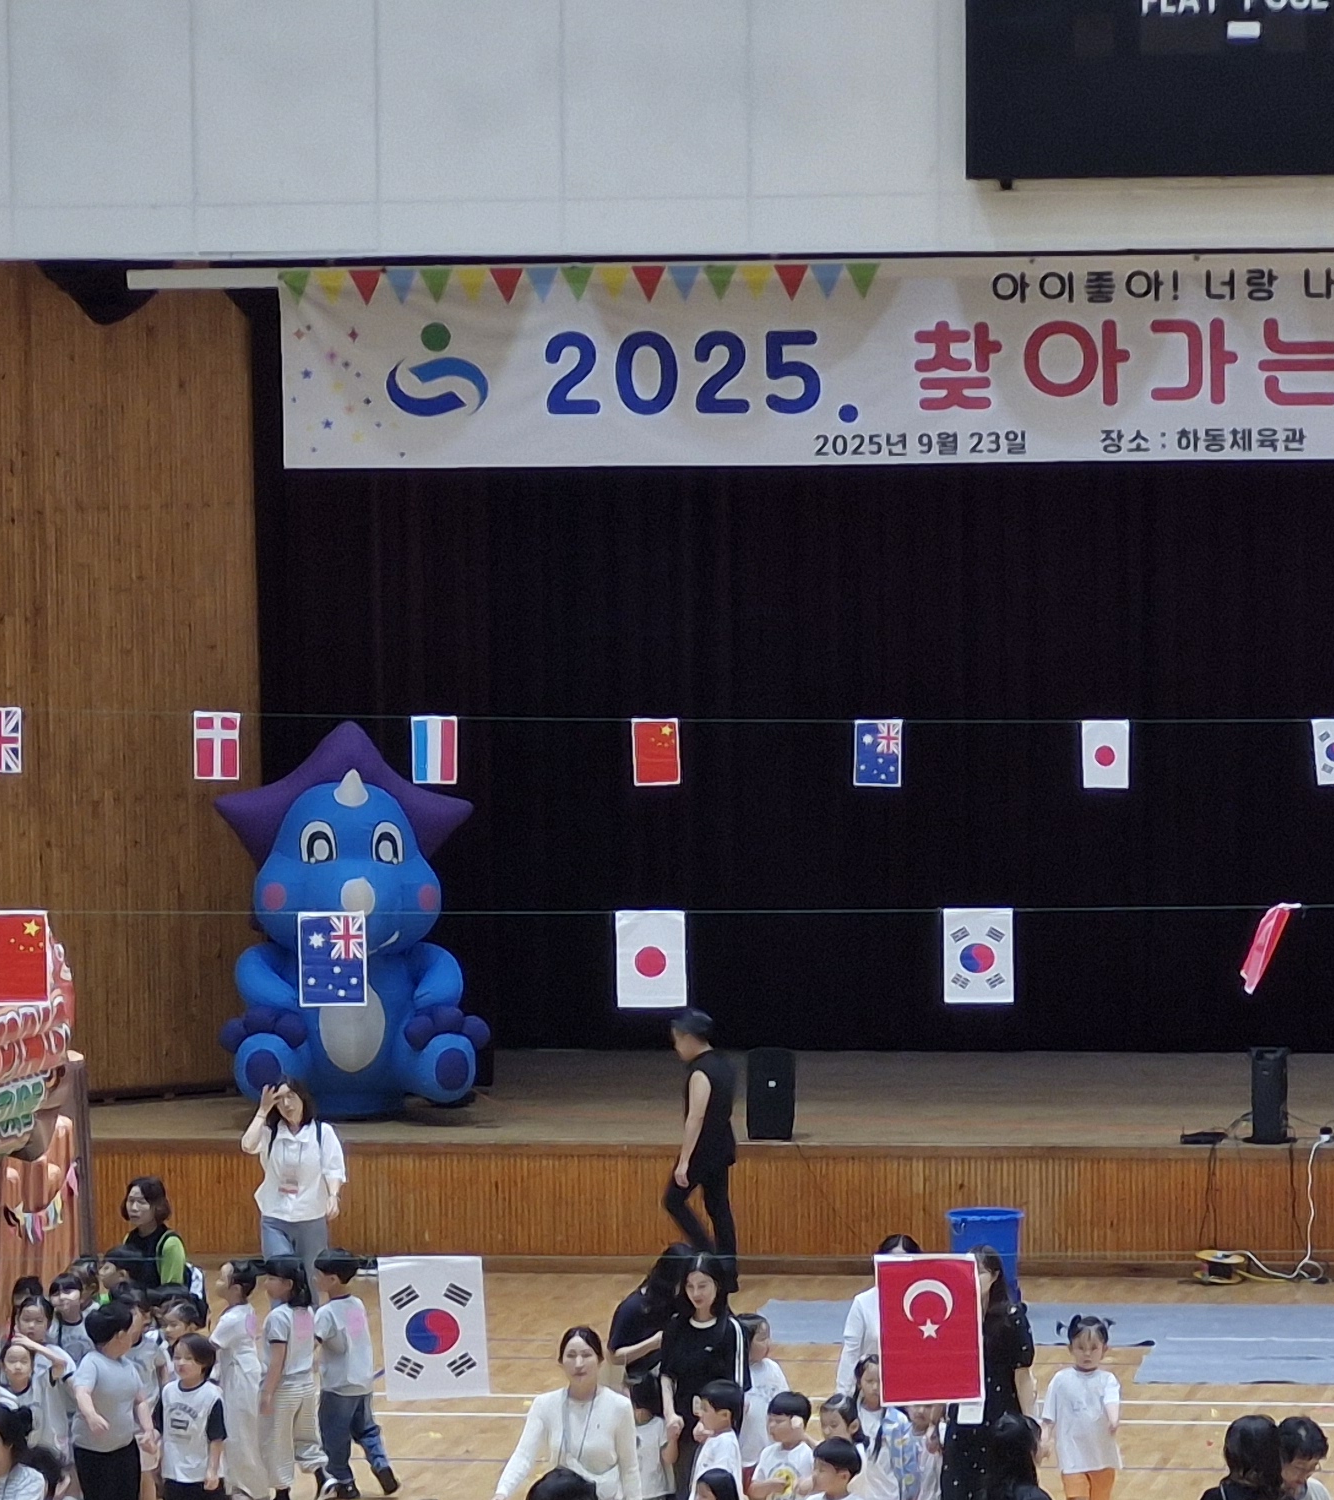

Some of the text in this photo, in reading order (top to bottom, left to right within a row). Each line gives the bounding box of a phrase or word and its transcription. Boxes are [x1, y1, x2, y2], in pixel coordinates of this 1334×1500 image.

[991, 269, 1180, 304] 아이좋아!
[1204, 267, 1280, 303] 너랑
[543, 328, 860, 424] 2025.
[813, 429, 1028, 458] 2025년 9월 23일
[1099, 428, 1152, 455] 장소
[1175, 427, 1307, 454] 하동체육관
